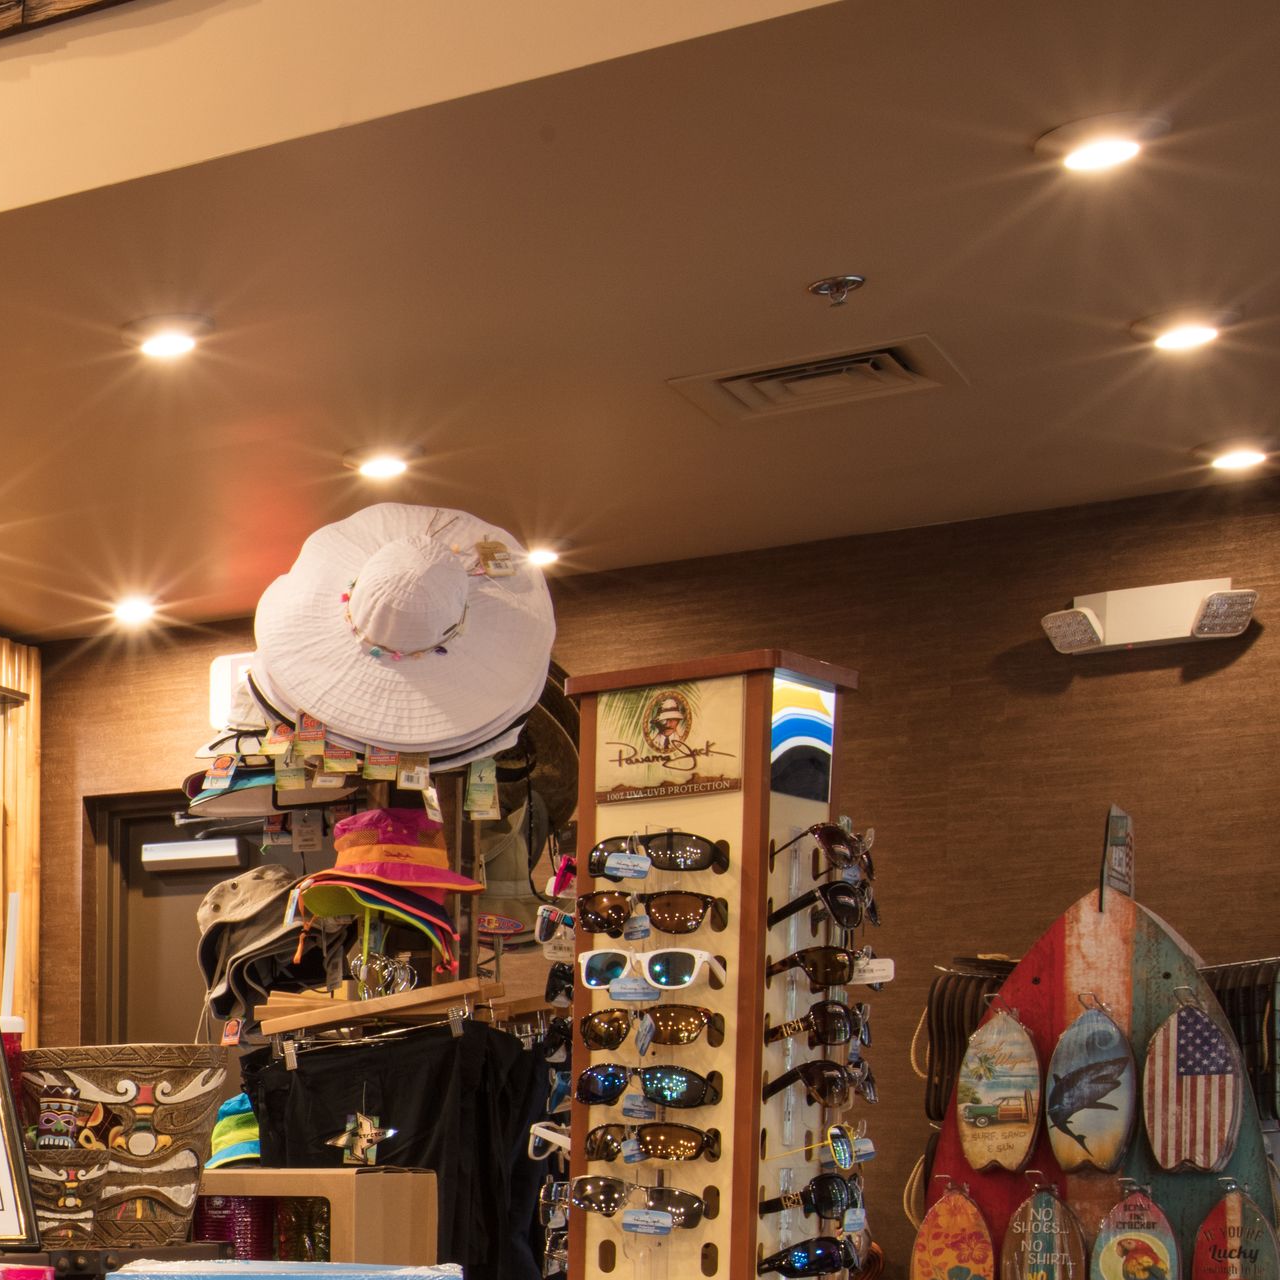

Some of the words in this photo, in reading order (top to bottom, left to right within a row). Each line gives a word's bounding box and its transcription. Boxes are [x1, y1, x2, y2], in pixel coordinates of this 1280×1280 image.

[626, 787, 666, 799] UVA-UVB
[668, 780, 730, 795] PROTECTION
[1030, 1207, 1053, 1221] NO
[1021, 1240, 1043, 1252] NO
[1208, 1244, 1260, 1263] Lucky
